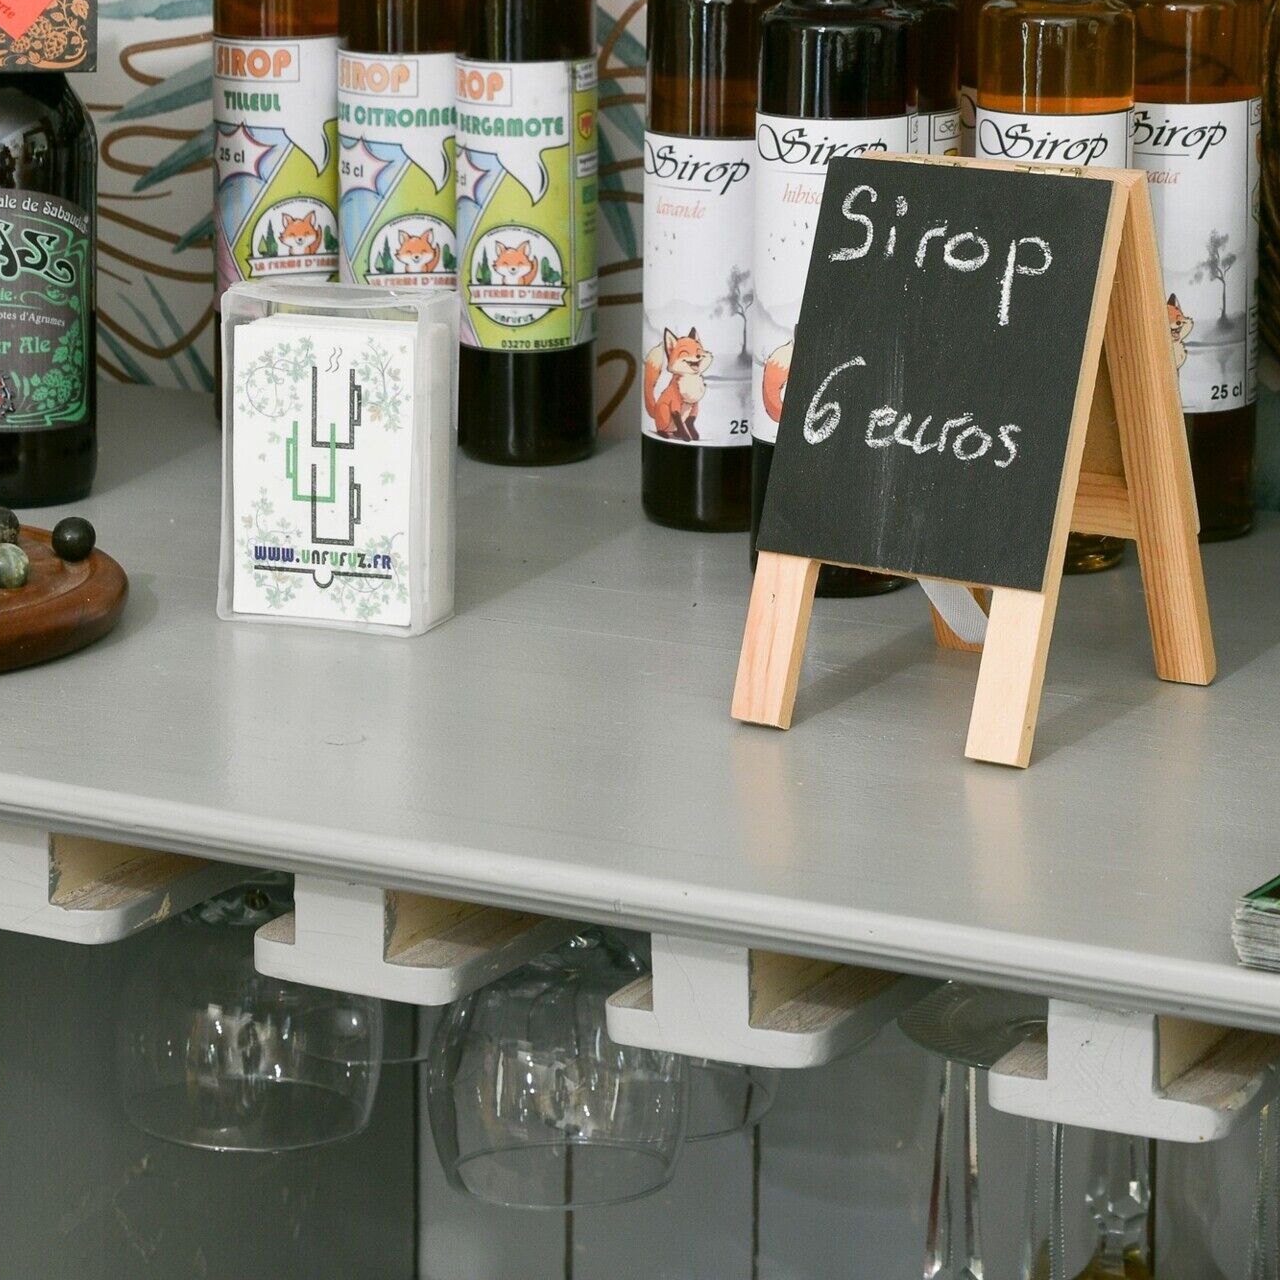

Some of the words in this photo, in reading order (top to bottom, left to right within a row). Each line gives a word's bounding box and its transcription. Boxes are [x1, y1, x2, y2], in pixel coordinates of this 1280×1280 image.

[216, 46, 292, 78] SIROP
[223, 90, 282, 113] TILLEUL
[978, 118, 1109, 167] Sirop
[219, 147, 231, 162] 25
[233, 149, 245, 163] cl
[353, 165, 364, 178] cl
[644, 139, 751, 196] Sirop
[21, 197, 39, 212] de
[655, 196, 707, 220] lavande
[827, 184, 1054, 327] Sirop
[19, 310, 66, 328] d'Agrumes
[18, 335, 52, 354] Ale
[501, 338, 532, 349] 03270
[533, 337, 571, 349] BUSSET
[1210, 385, 1230, 401] 25
[1231, 382, 1243, 397] cl
[802, 355, 868, 446] 6
[864, 403, 1022, 470] euros
[729, 419, 750, 435] 25
